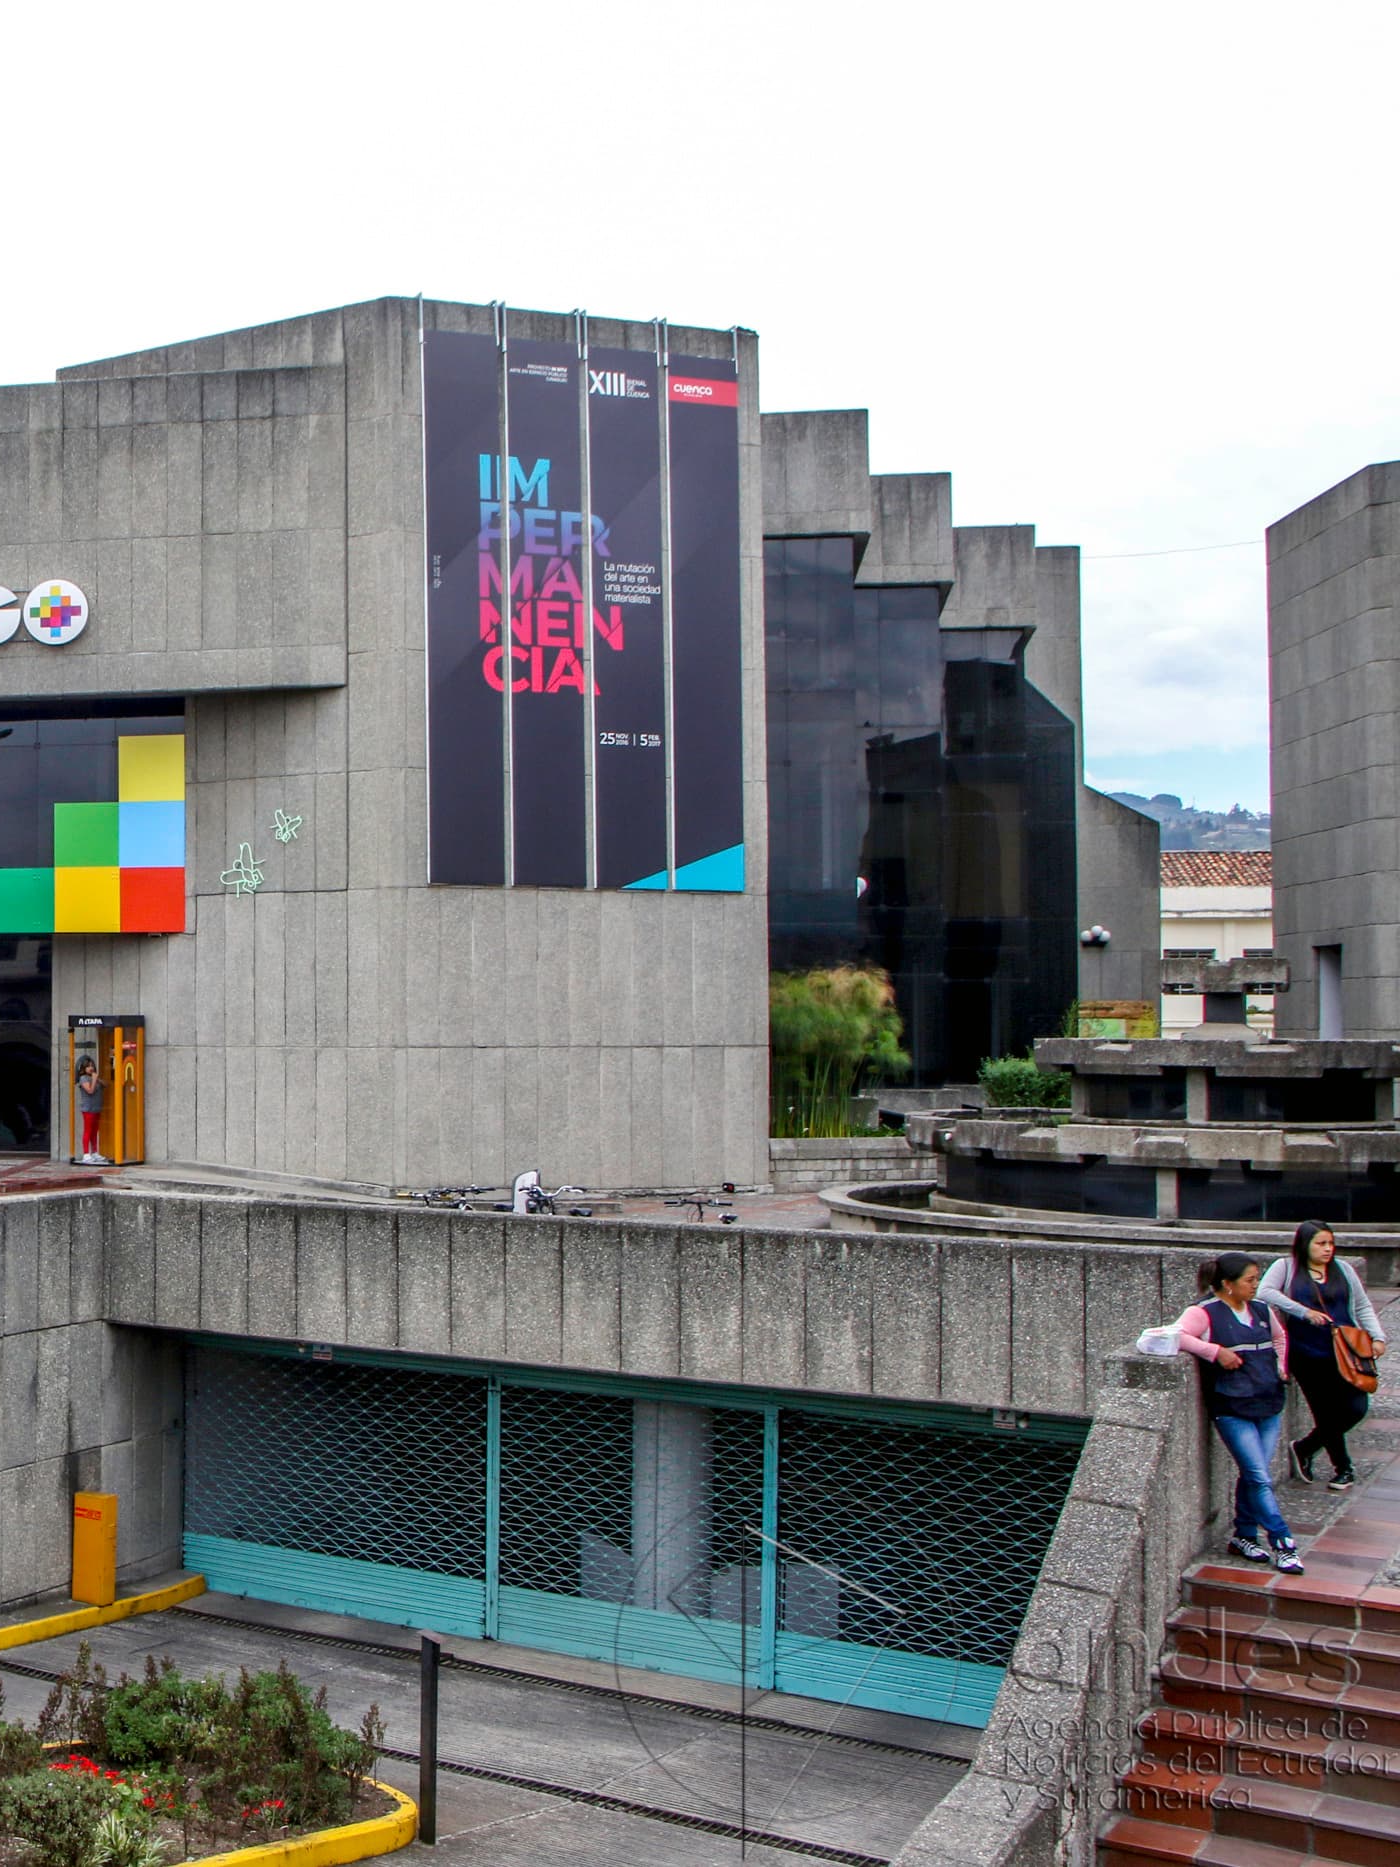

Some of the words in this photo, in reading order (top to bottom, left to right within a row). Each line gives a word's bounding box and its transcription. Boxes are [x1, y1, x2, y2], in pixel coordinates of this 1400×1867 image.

[589, 370, 626, 397] XIII
[627, 379, 647, 387] BIENAL
[627, 391, 650, 399] CUENCA
[673, 384, 713, 396] cuenca
[478, 501, 611, 557] PER
[603, 561, 615, 571] La
[616, 563, 655, 574] mutación
[478, 552, 588, 601] MA
[604, 572, 618, 582] del
[619, 574, 636, 583] arte
[637, 575, 649, 583] en
[605, 584, 621, 592] una
[622, 585, 661, 595] sociedad
[605, 593, 651, 604] materialista
[479, 600, 624, 651] NEN
[482, 646, 601, 695] CIA
[600, 732, 616, 745] 25
[640, 734, 648, 747] 5
